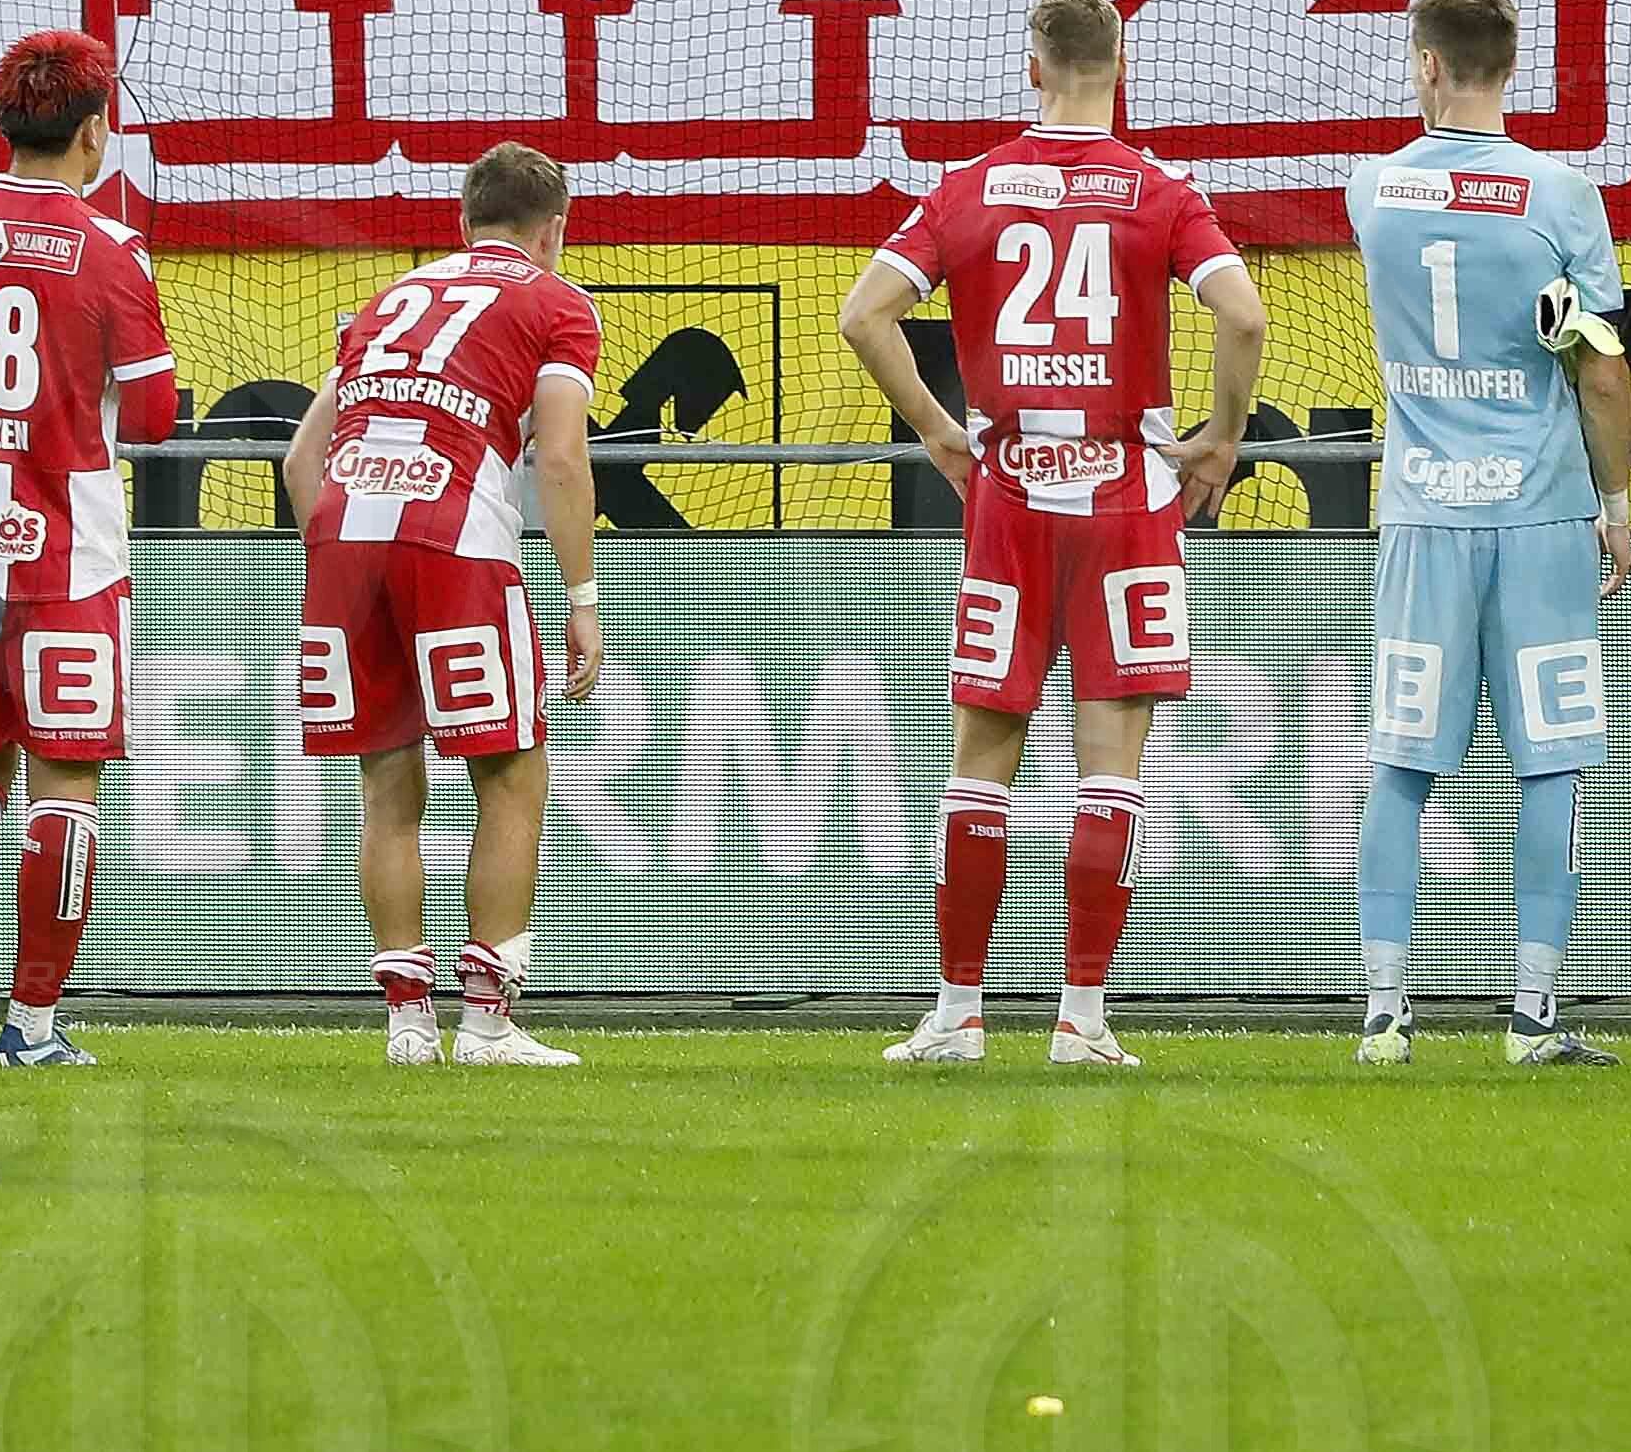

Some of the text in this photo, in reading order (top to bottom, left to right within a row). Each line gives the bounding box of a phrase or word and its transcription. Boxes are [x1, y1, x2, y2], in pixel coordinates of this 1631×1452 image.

[990, 180, 1060, 200] SORGER
[1378, 180, 1527, 203] SORGER SALANETTIS
[995, 223, 1120, 346] 24
[1420, 239, 1461, 360] 1
[359, 284, 501, 375] 27
[1002, 353, 1113, 387] DRESSEL
